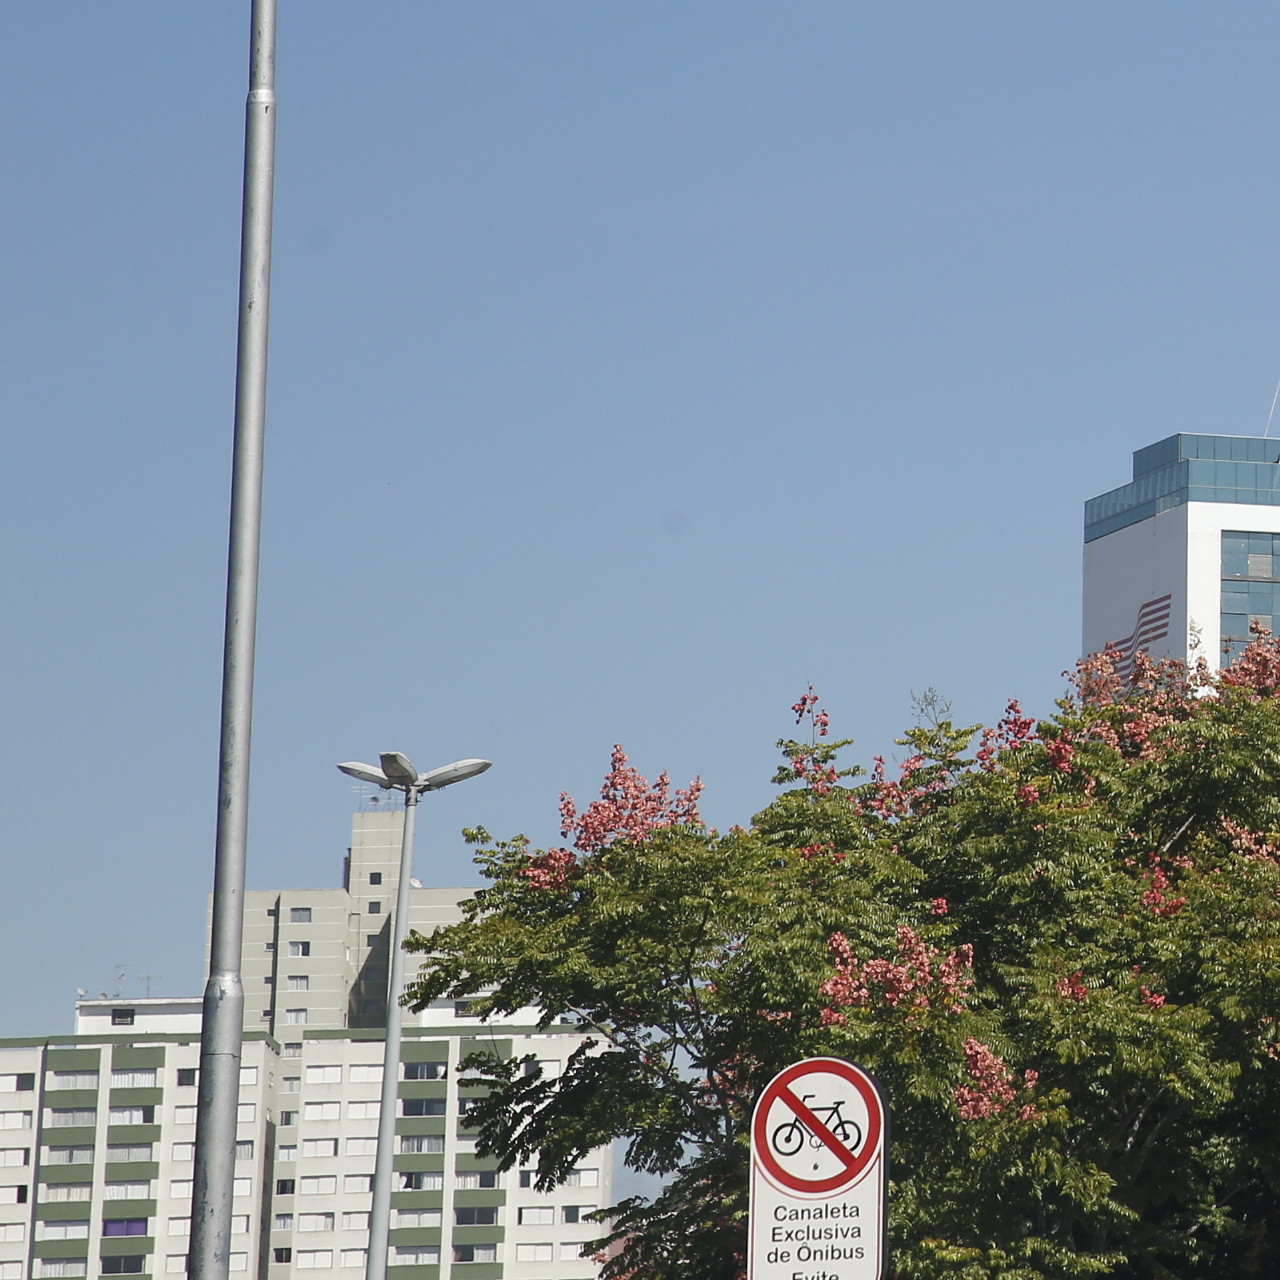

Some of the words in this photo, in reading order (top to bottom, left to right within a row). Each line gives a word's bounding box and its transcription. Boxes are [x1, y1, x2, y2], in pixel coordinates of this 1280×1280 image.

[773, 1202, 860, 1221] Canaleta
[771, 1223, 861, 1242] Exclusiva
[766, 1247, 791, 1264] de
[797, 1241, 865, 1262] Ônibus
